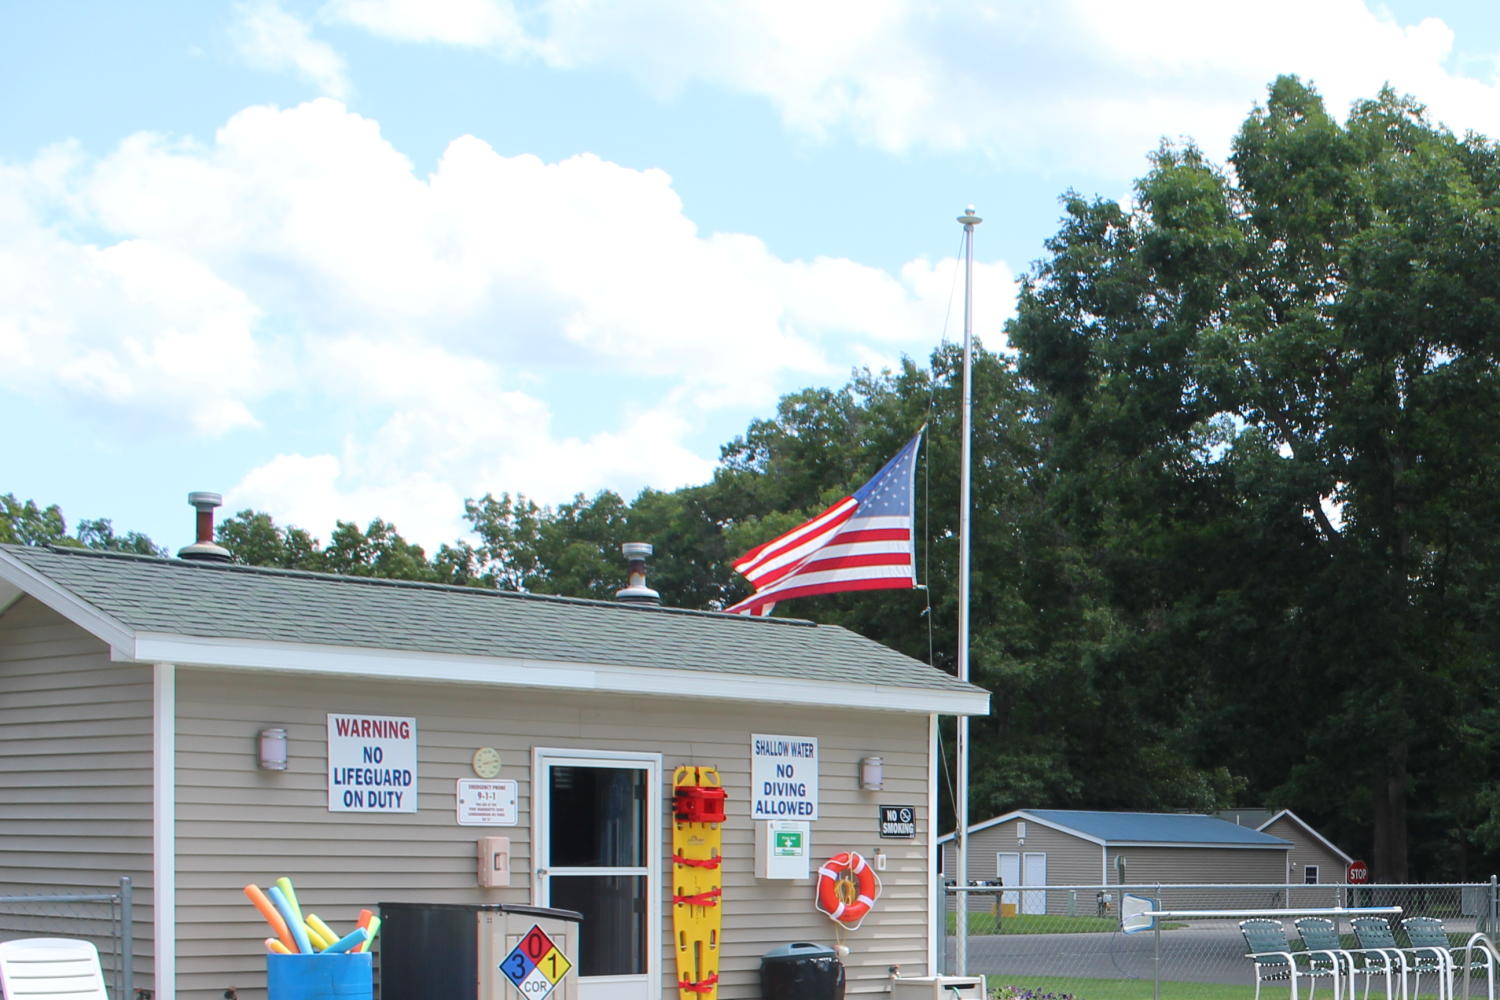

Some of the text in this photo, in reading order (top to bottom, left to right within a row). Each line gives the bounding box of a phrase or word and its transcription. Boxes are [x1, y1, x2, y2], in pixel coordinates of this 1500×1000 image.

[335, 718, 410, 739] WARNING
[363, 746, 383, 764] NO
[755, 739, 814, 758] SHALLOW WATER
[334, 767, 412, 787] LIFEGUARD
[776, 764, 794, 778] NO
[477, 791, 496, 801] 9-1-1
[764, 782, 806, 797] DIVING
[343, 790, 403, 808] ON DUTY
[755, 800, 814, 816] ALLOWED
[886, 809, 898, 822] NO
[882, 822, 914, 835] SMOKING
[1350, 868, 1367, 880] STOP
[528, 933, 542, 959] 0
[511, 953, 557, 979] 3 1
[524, 981, 547, 993] COR
